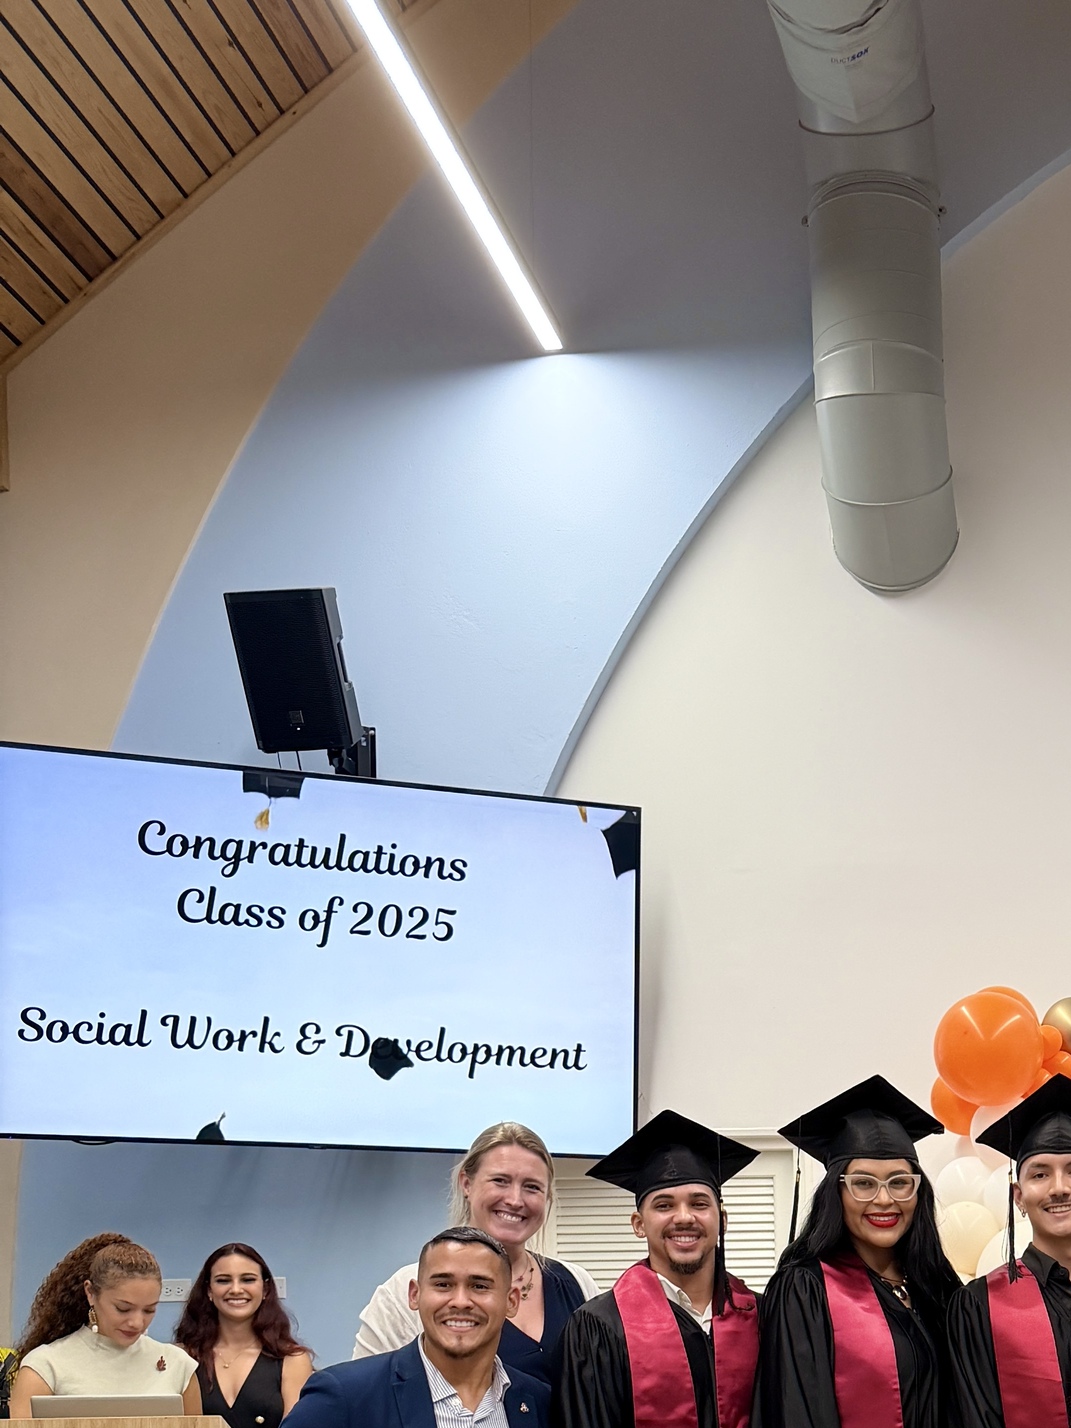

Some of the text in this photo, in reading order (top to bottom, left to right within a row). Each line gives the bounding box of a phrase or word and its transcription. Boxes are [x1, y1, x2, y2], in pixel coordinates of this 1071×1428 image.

[138, 820, 468, 882] Congratulations
[178, 886, 457, 948] Class of 2025
[18, 1007, 152, 1048] Social
[161, 1015, 285, 1054] Work
[296, 1023, 326, 1056] &
